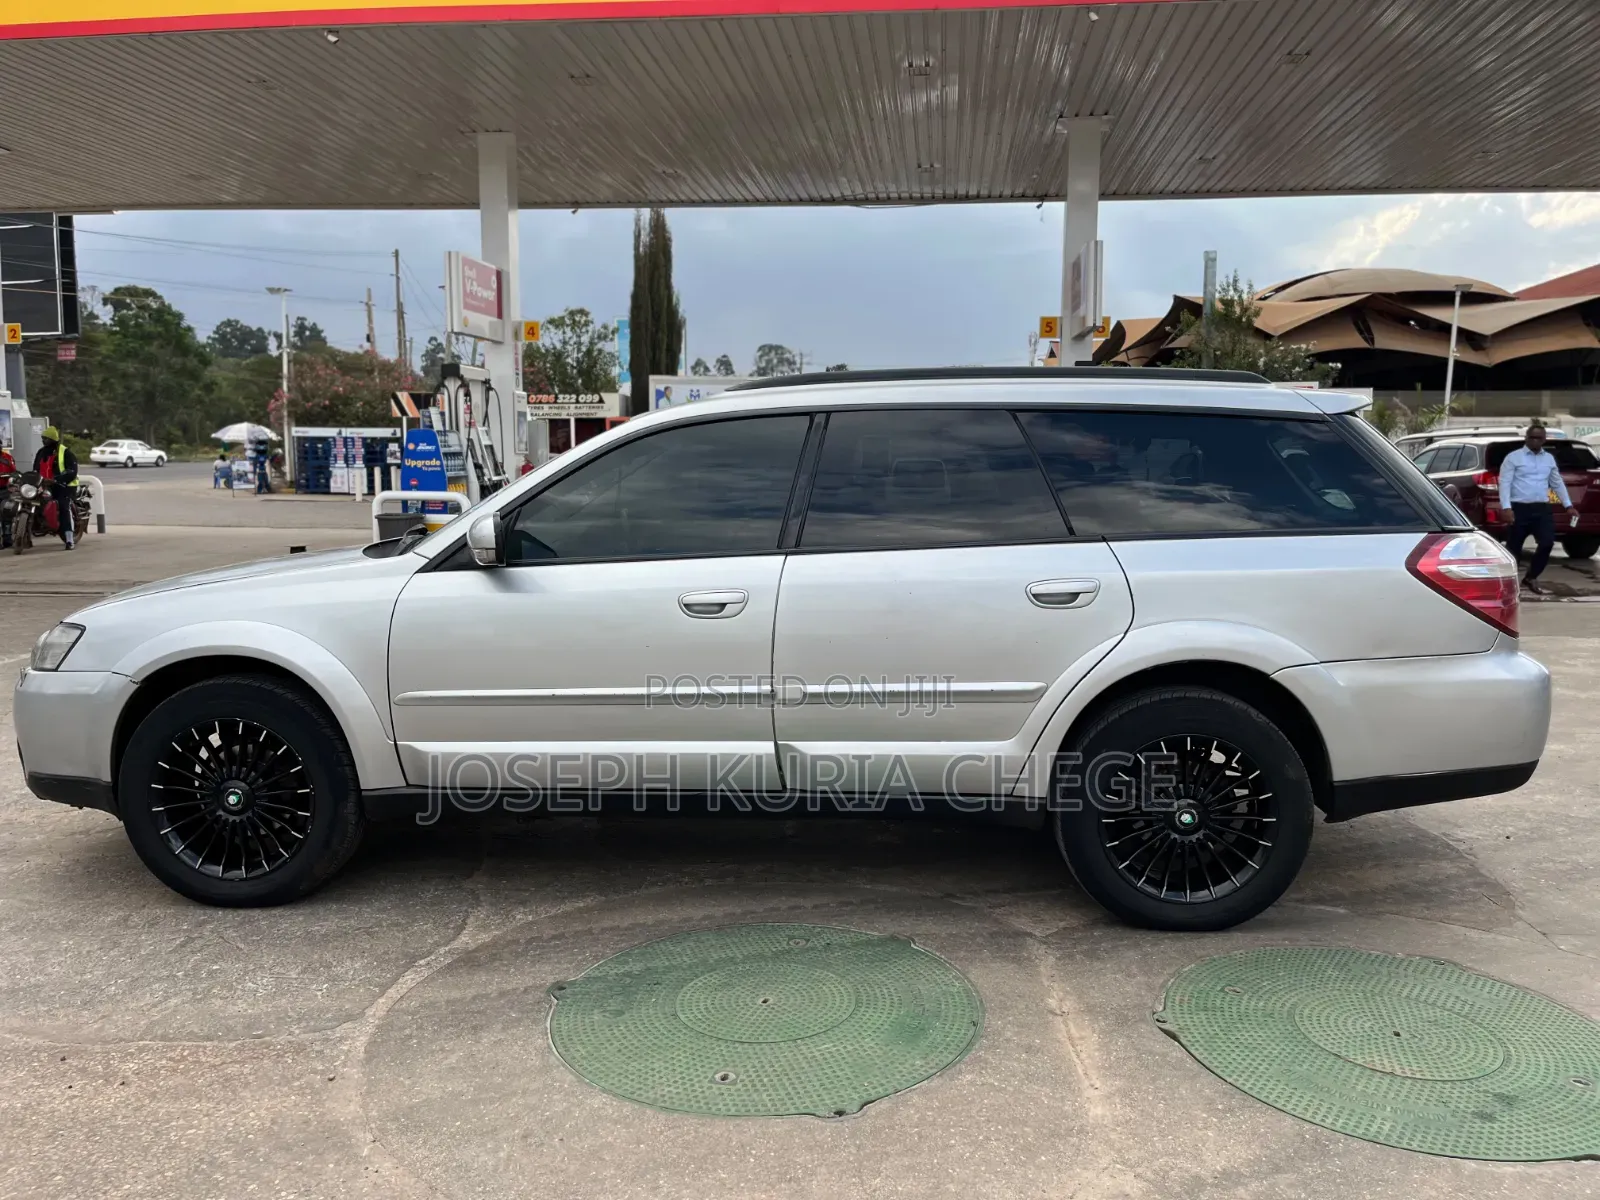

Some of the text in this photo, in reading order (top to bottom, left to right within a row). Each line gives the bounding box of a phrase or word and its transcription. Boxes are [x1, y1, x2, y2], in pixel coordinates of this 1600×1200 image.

[526, 326, 536, 338] 4
[1044, 321, 1053, 334] 5
[9, 328, 18, 339] 2
[528, 394, 555, 403] 0786
[556, 394, 577, 403] 322
[578, 394, 600, 403] 099
[405, 458, 440, 467] Upgrade
